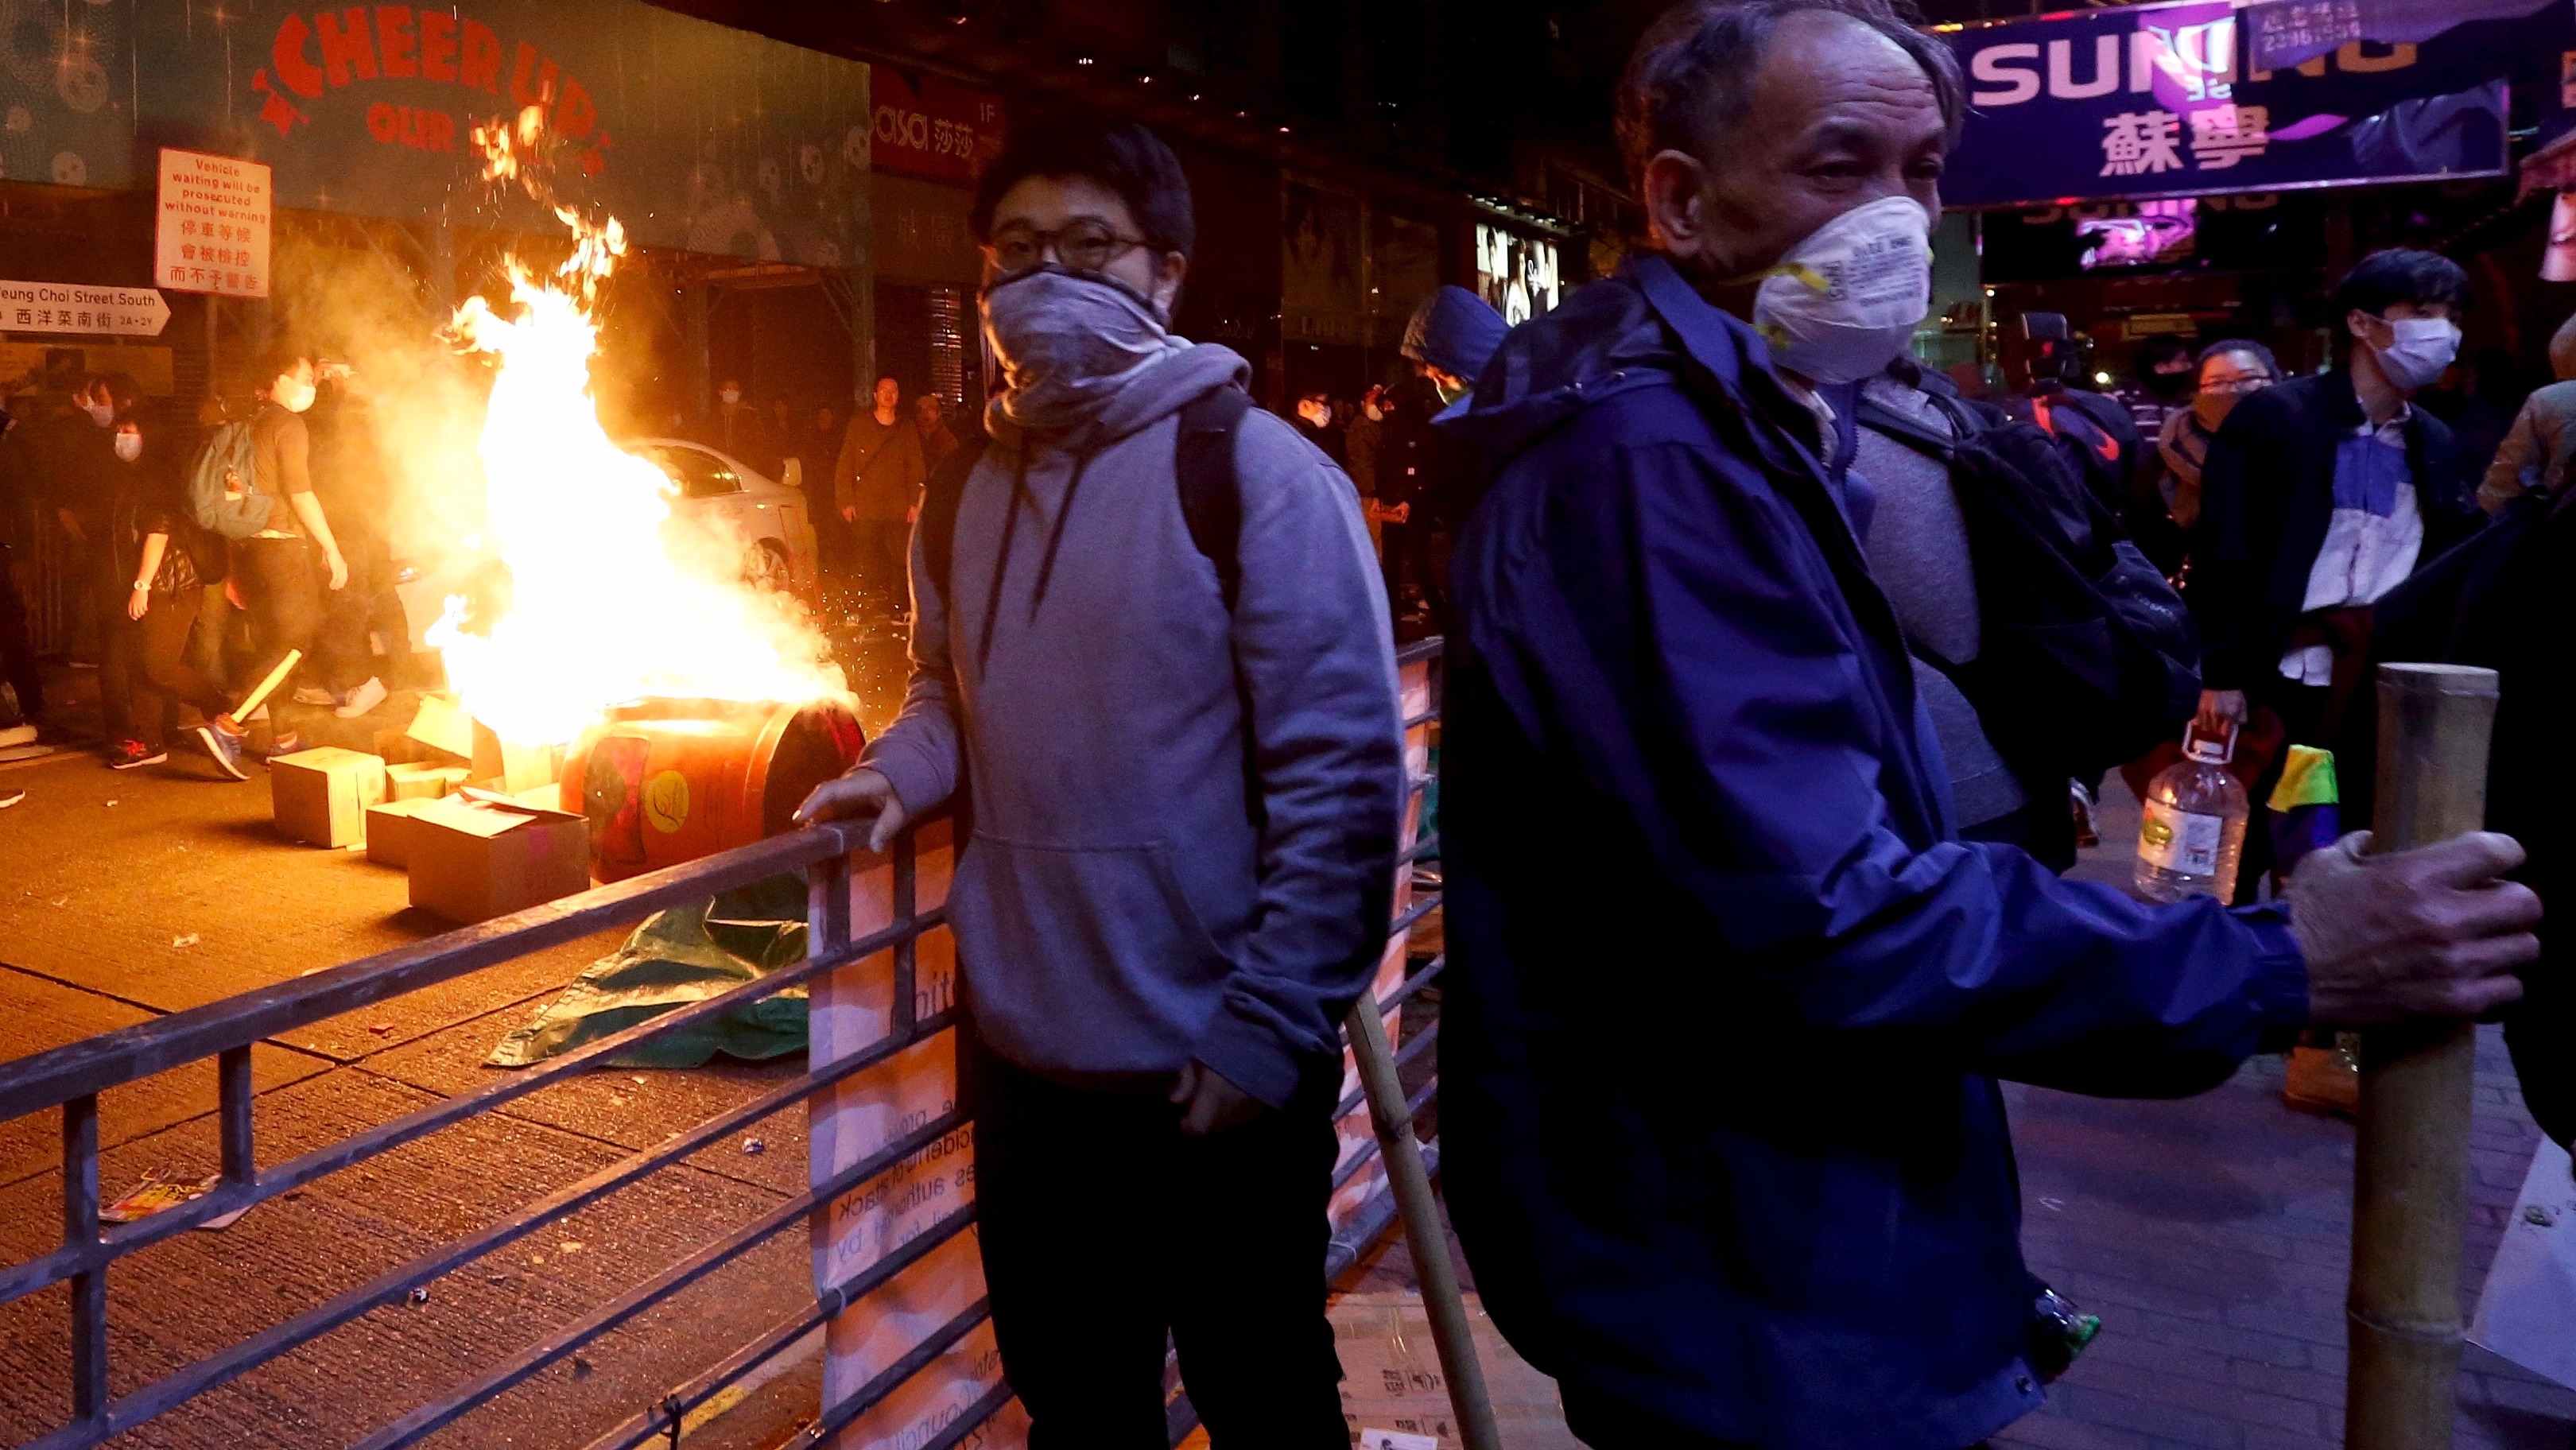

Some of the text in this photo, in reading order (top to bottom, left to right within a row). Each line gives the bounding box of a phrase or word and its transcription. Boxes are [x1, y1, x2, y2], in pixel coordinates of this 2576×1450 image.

[273, 6, 598, 140] CHEER UP
[367, 102, 455, 153] OUR
[873, 105, 928, 151] asa
[933, 118, 974, 159] 莎莎
[196, 159, 240, 176] Vehicle
[173, 173, 261, 194] waiting will be
[182, 188, 251, 206] prosecuted
[165, 200, 266, 225] without warning
[181, 219, 251, 243] 停車等候
[170, 266, 258, 289] 而不予警告
[0, 288, 155, 307] eung Choi Street South
[16, 308, 112, 328] 西洋菜南街
